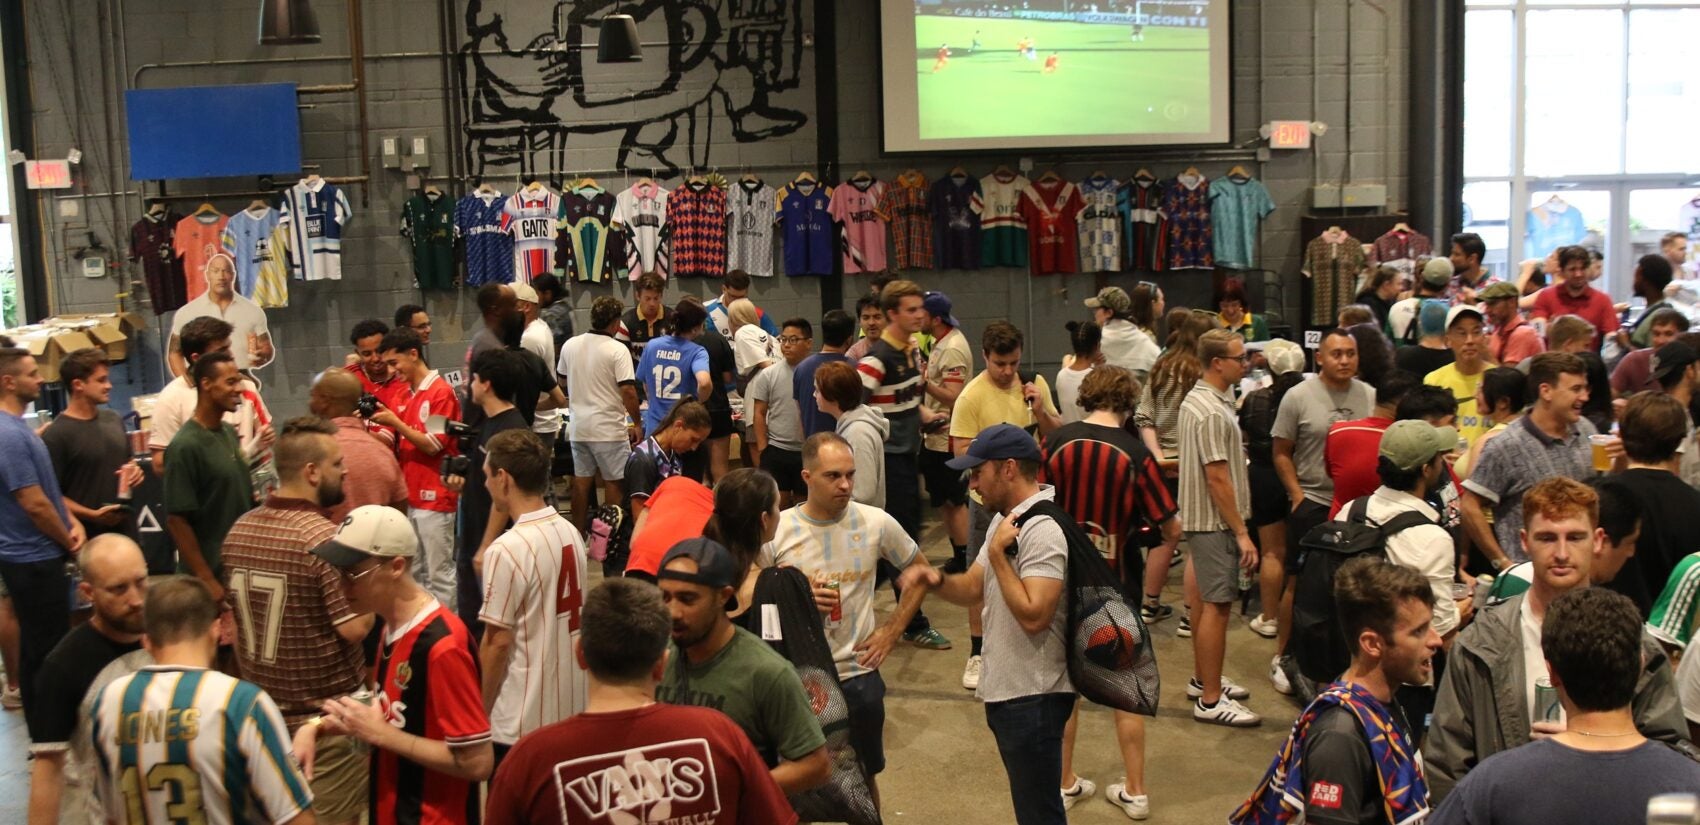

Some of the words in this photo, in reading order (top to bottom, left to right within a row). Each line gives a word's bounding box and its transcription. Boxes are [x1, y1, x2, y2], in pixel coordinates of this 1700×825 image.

[1088, 14, 1146, 22] VOLKSWAGN
[1279, 124, 1304, 145] EXIT
[1307, 332, 1319, 344] 22
[656, 349, 681, 361] FALCÃO
[447, 372, 460, 384] 14
[652, 364, 682, 400] 12
[556, 543, 584, 636] 4
[230, 567, 288, 664] 17
[114, 708, 201, 746] JONES
[119, 763, 207, 825] 13
[564, 757, 705, 820] VANS
[1312, 791, 1338, 803] CARD
[1314, 782, 1339, 795] RED
